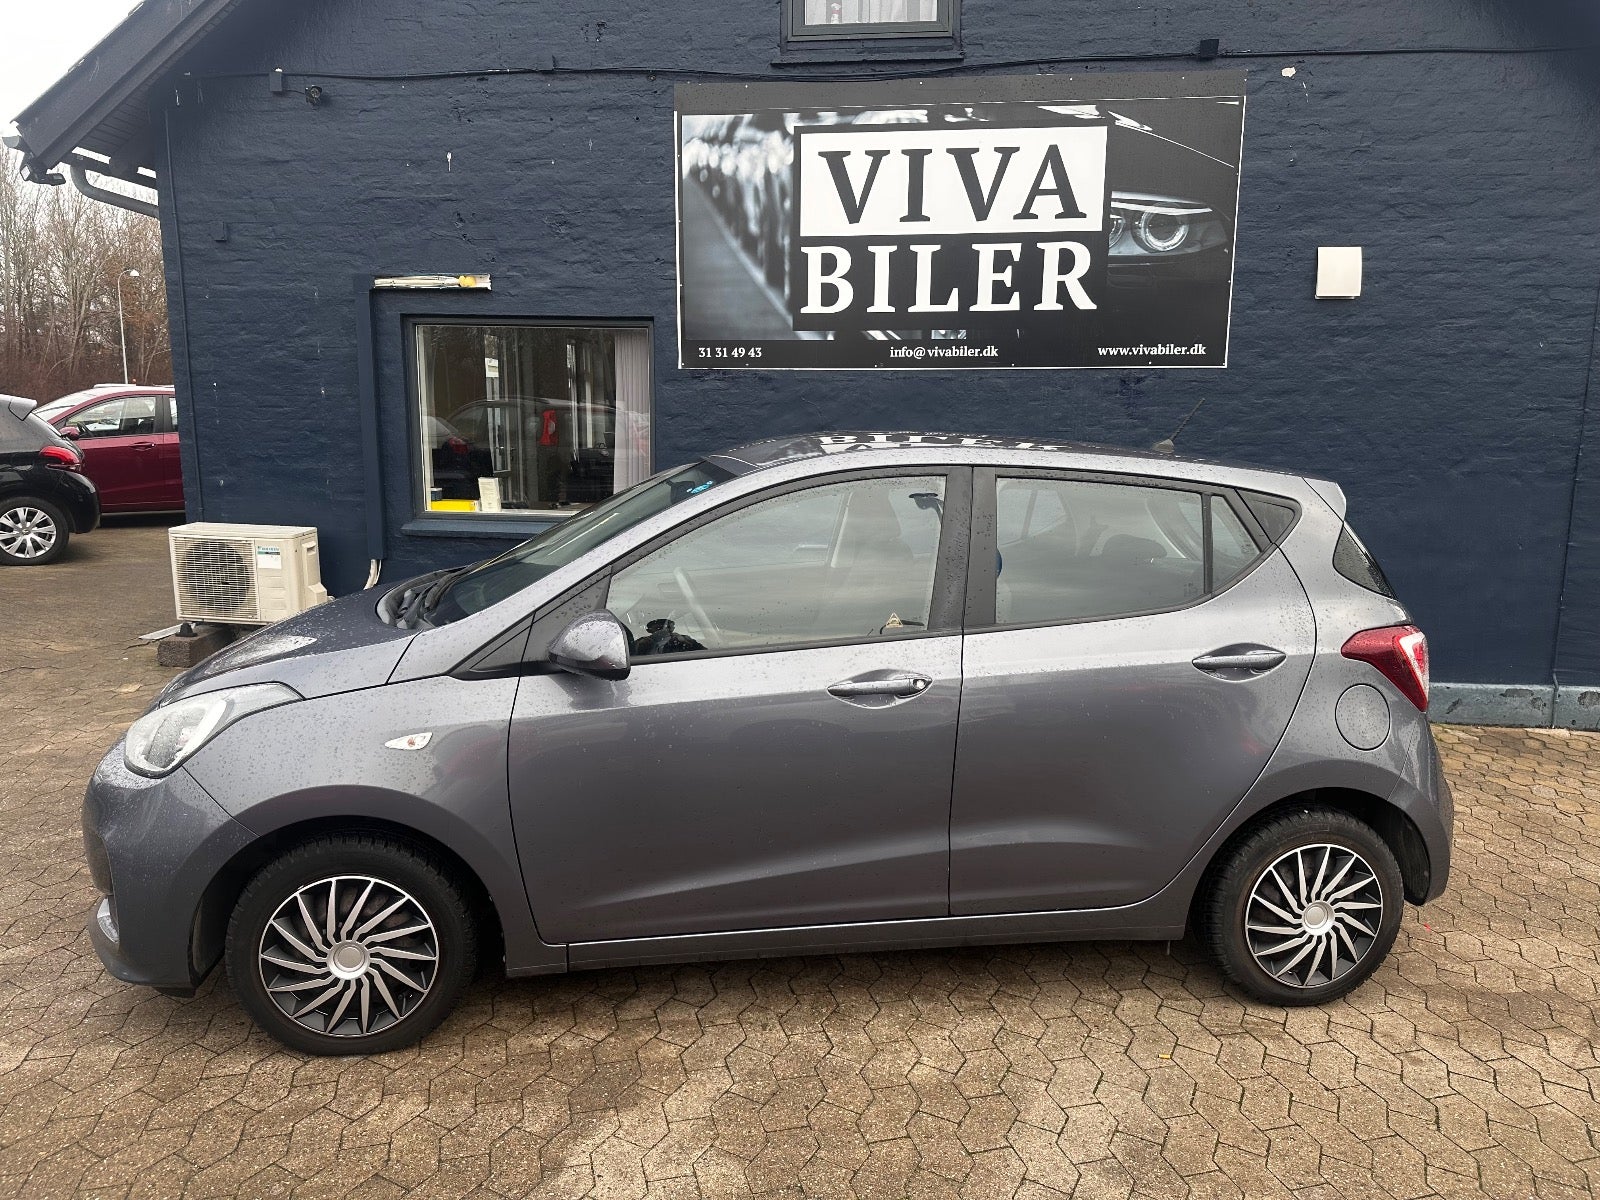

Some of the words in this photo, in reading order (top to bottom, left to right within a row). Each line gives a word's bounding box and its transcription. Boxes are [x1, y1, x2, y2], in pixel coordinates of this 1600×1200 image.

[818, 144, 1088, 225] VIVA
[801, 241, 1098, 314] BILER
[698, 347, 712, 358] 31
[715, 347, 729, 358] 31
[731, 347, 746, 358] 49
[747, 347, 762, 358] 43
[1097, 343, 1207, 357] www.vivabiler.dk
